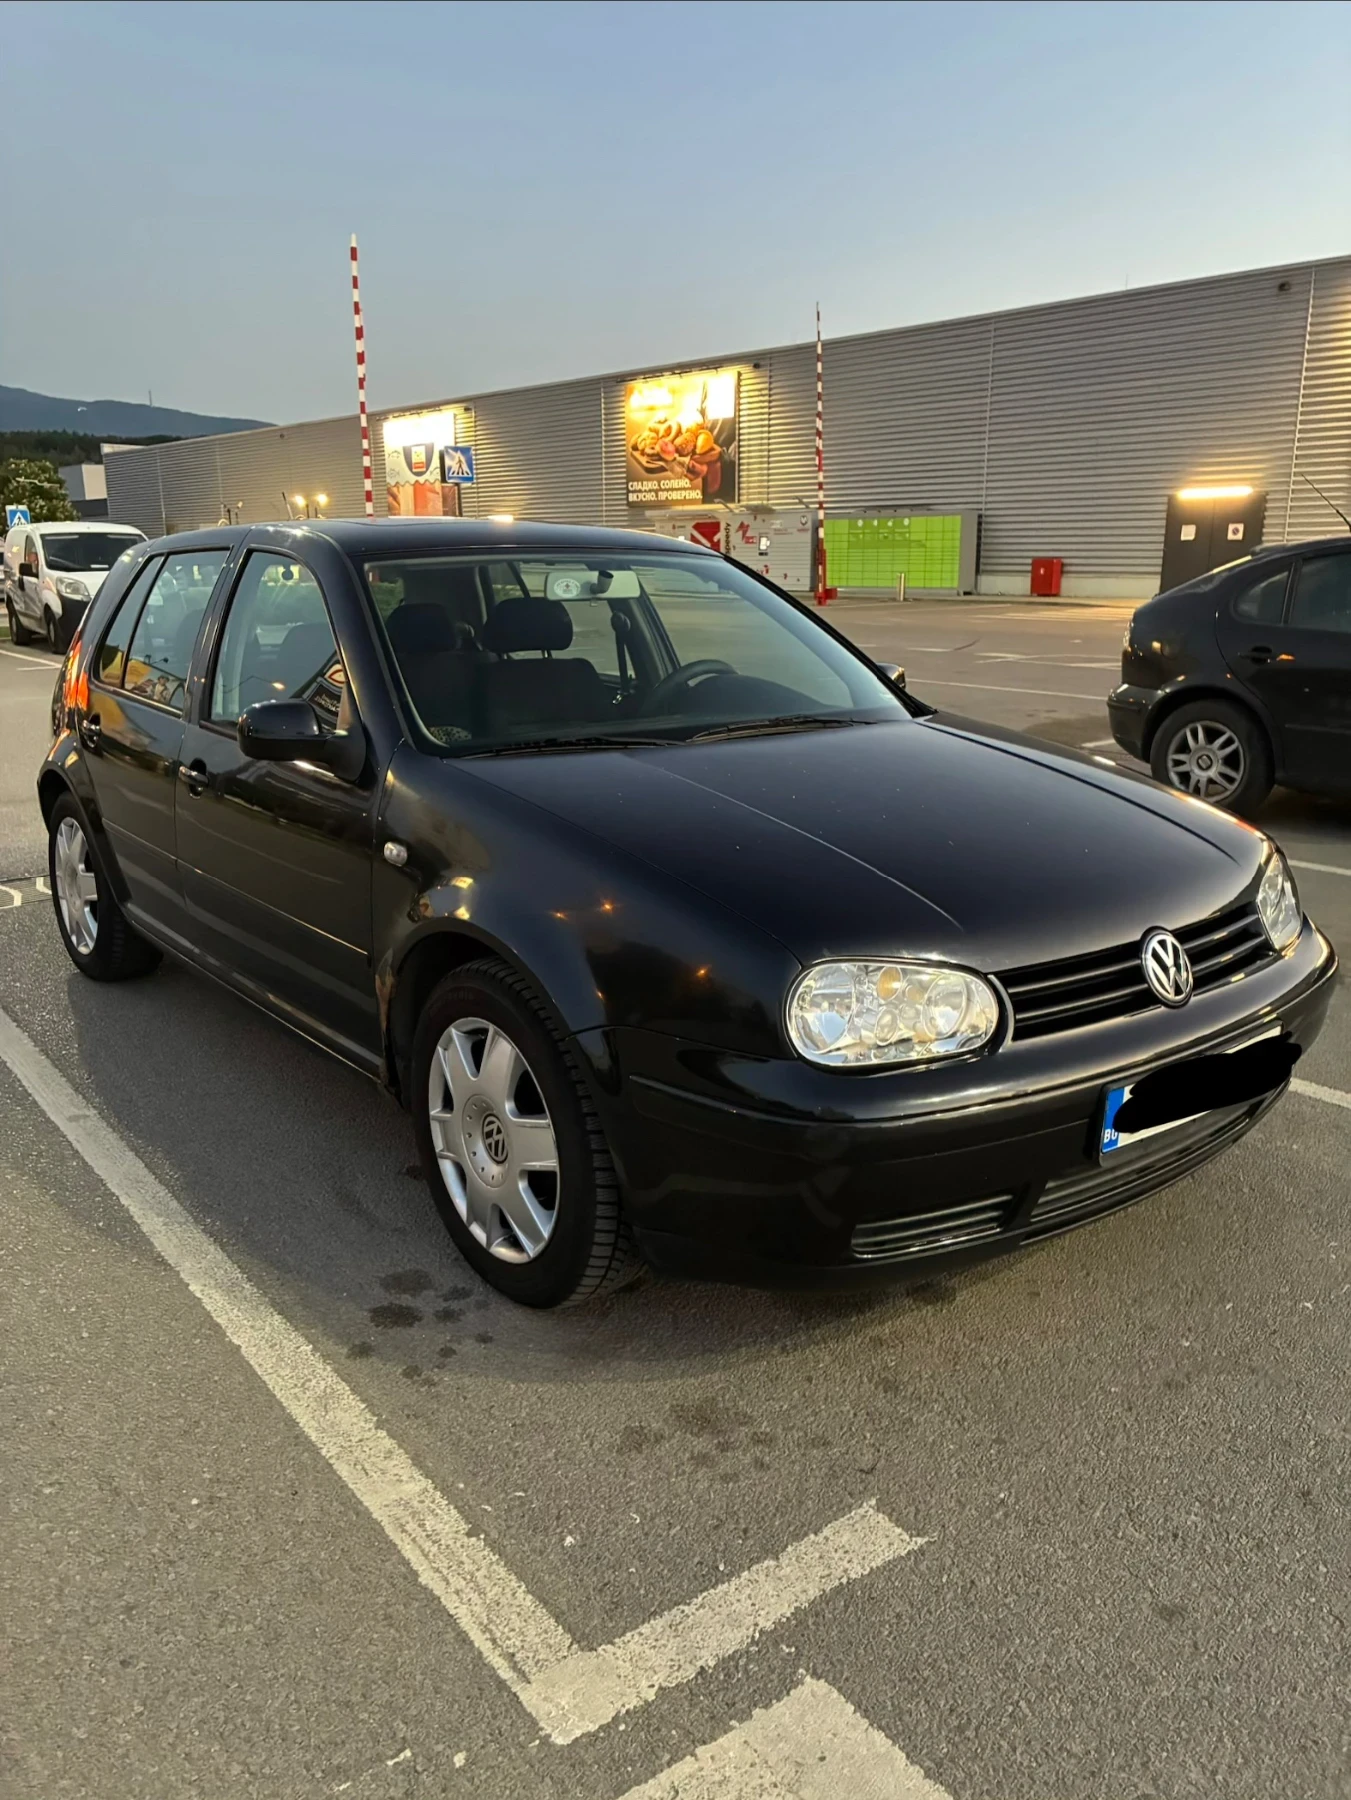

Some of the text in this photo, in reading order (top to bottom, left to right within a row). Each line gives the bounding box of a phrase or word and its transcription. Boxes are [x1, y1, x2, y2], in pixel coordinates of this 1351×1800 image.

[628, 479, 692, 491] СЛАДКО. СОЛЕНО.
[628, 490, 703, 502] ВКУСНО. ПРОВЕРЕНО.
